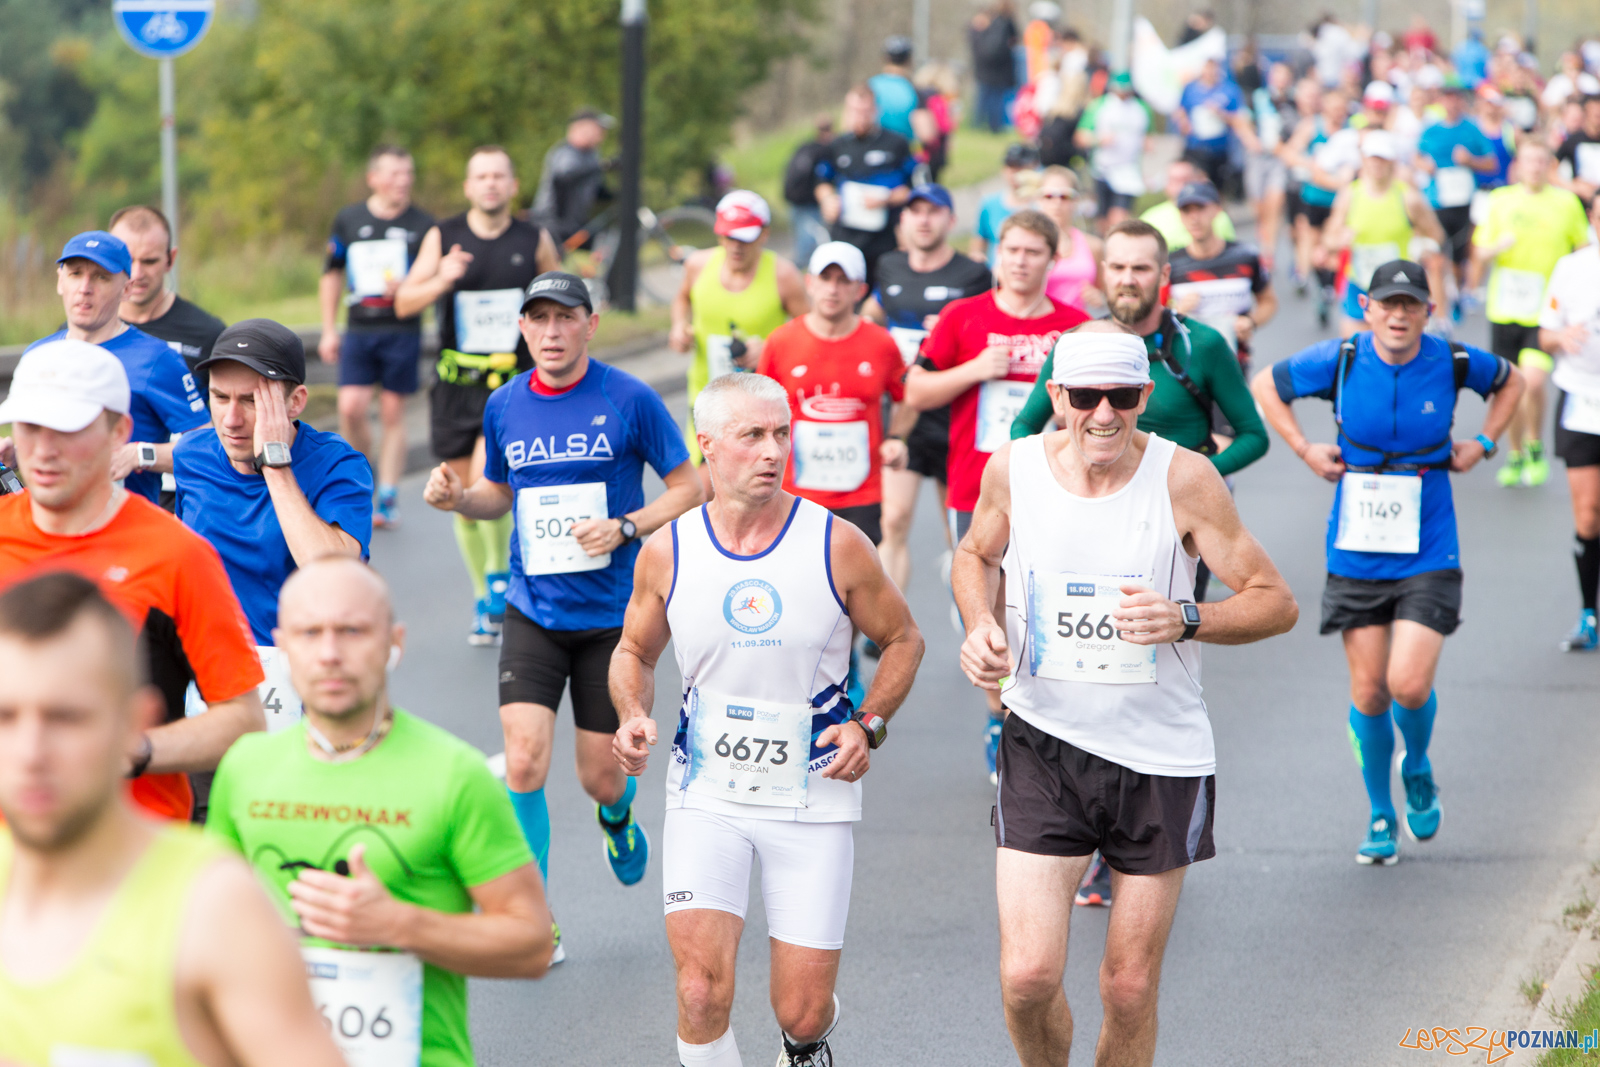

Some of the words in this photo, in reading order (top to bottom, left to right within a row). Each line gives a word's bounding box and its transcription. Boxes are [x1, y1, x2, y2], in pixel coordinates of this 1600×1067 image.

[1359, 502, 1402, 519] 1149
[731, 639, 782, 649] 11.09.2011
[1075, 641, 1116, 652] Grzegorz
[714, 732, 788, 766] 6673
[729, 762, 769, 774] BOGDAN
[248, 801, 412, 828] CZERWONAK
